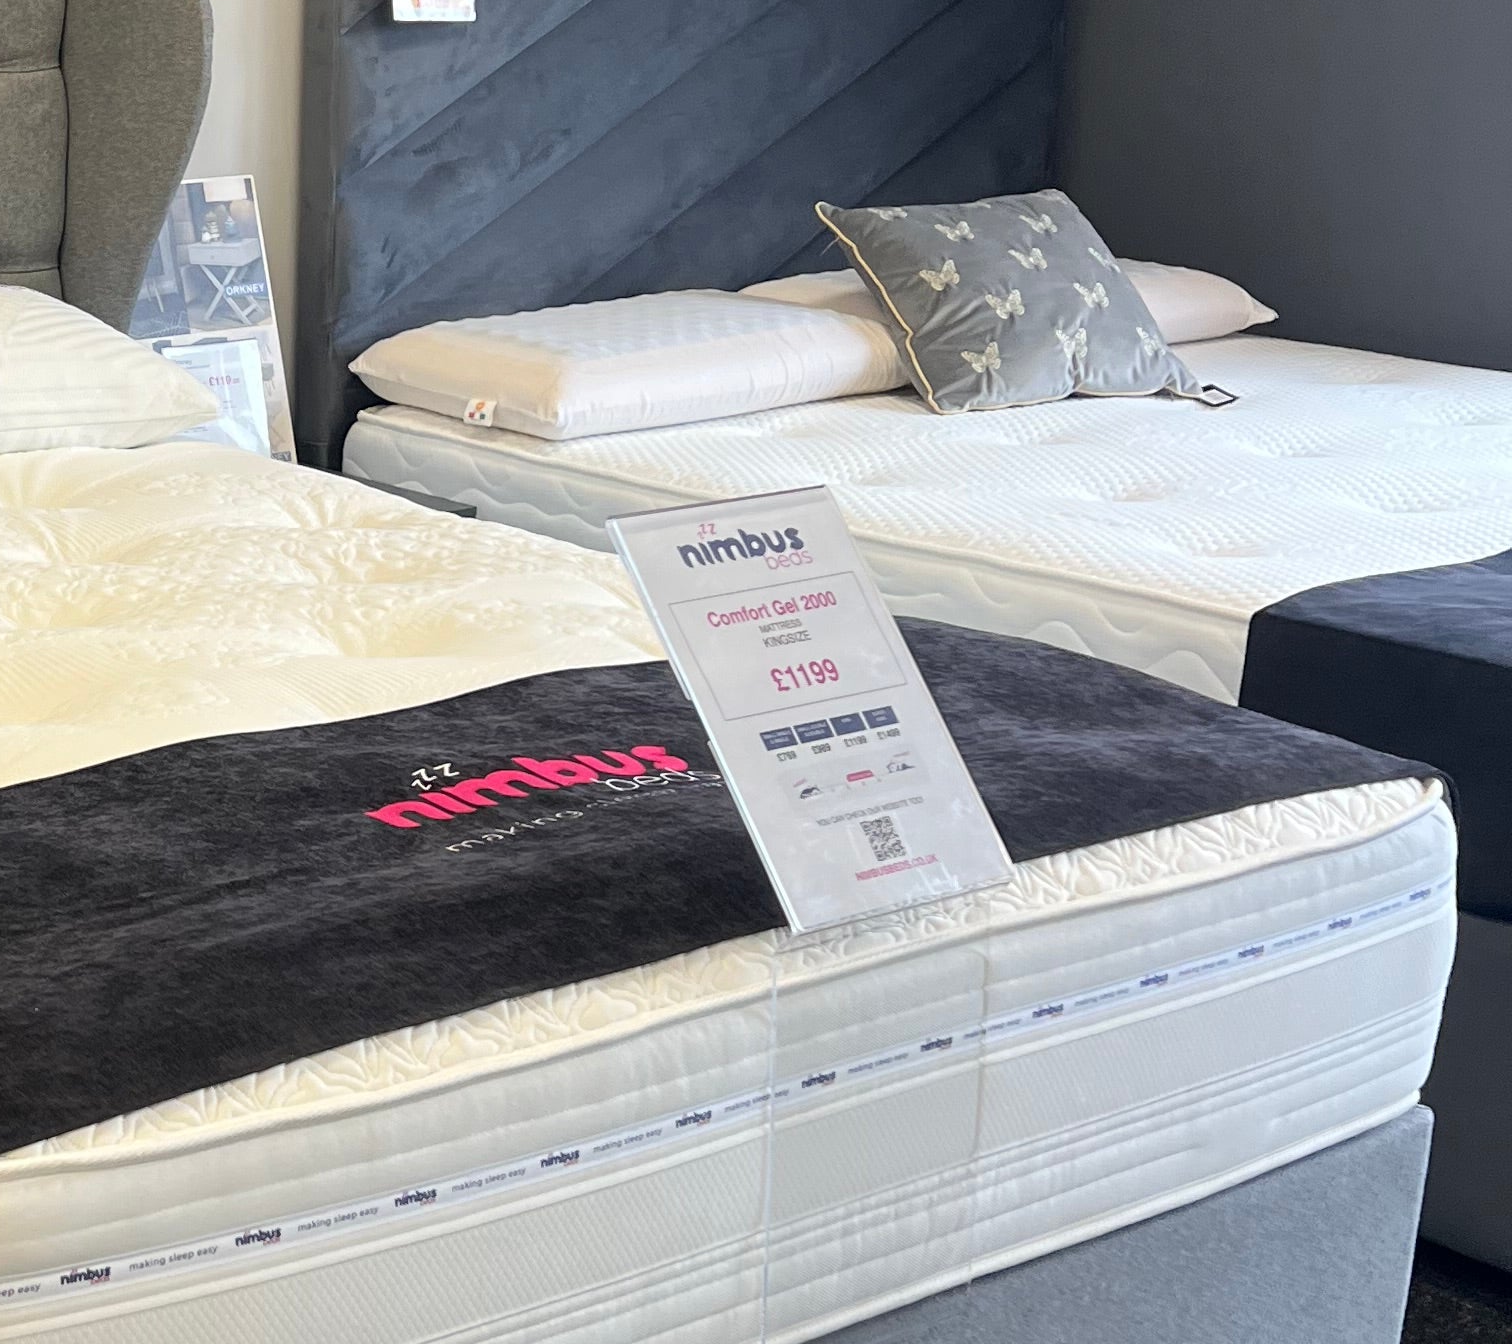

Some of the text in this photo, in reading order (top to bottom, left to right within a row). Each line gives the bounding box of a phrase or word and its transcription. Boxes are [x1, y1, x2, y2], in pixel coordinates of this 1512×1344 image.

[226, 283, 265, 296] ORKNEY
[676, 527, 804, 568] nimbus
[707, 590, 837, 627] Comfort Gel 2000
[758, 618, 802, 633] MATTRESS
[770, 658, 839, 692] £1199
[364, 746, 689, 828] nimbus
[17, 1283, 42, 1295] easy
[60, 1266, 111, 1286] nimbus
[128, 1255, 166, 1272] making
[168, 1248, 196, 1264] sleep
[196, 1244, 219, 1257] easy
[235, 1226, 282, 1248] nimbus
